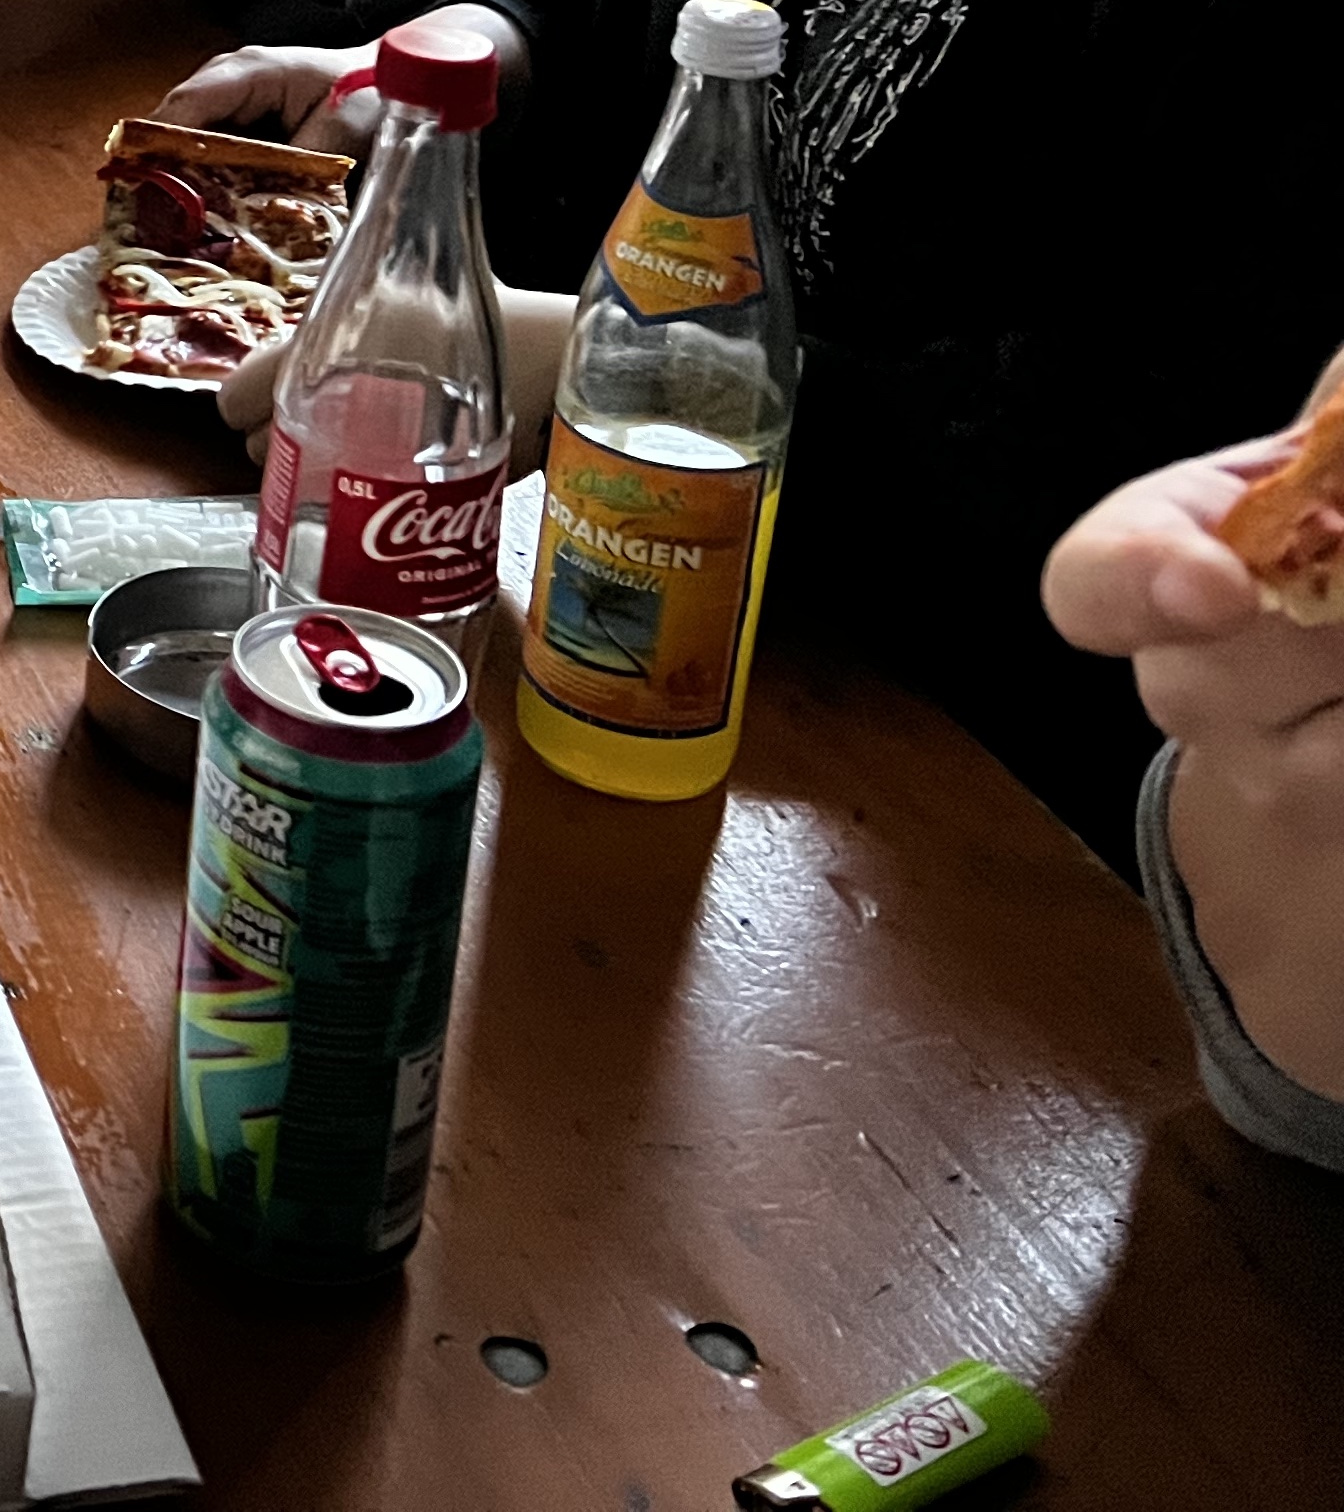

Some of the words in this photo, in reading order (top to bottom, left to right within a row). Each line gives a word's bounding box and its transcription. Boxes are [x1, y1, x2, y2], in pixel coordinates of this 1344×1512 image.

[615, 241, 727, 293] ORANGEN
[547, 491, 703, 571] ORANGEN
[199, 756, 292, 845] STAR
[221, 911, 280, 956] APPLE
[231, 896, 283, 936] SOUR
